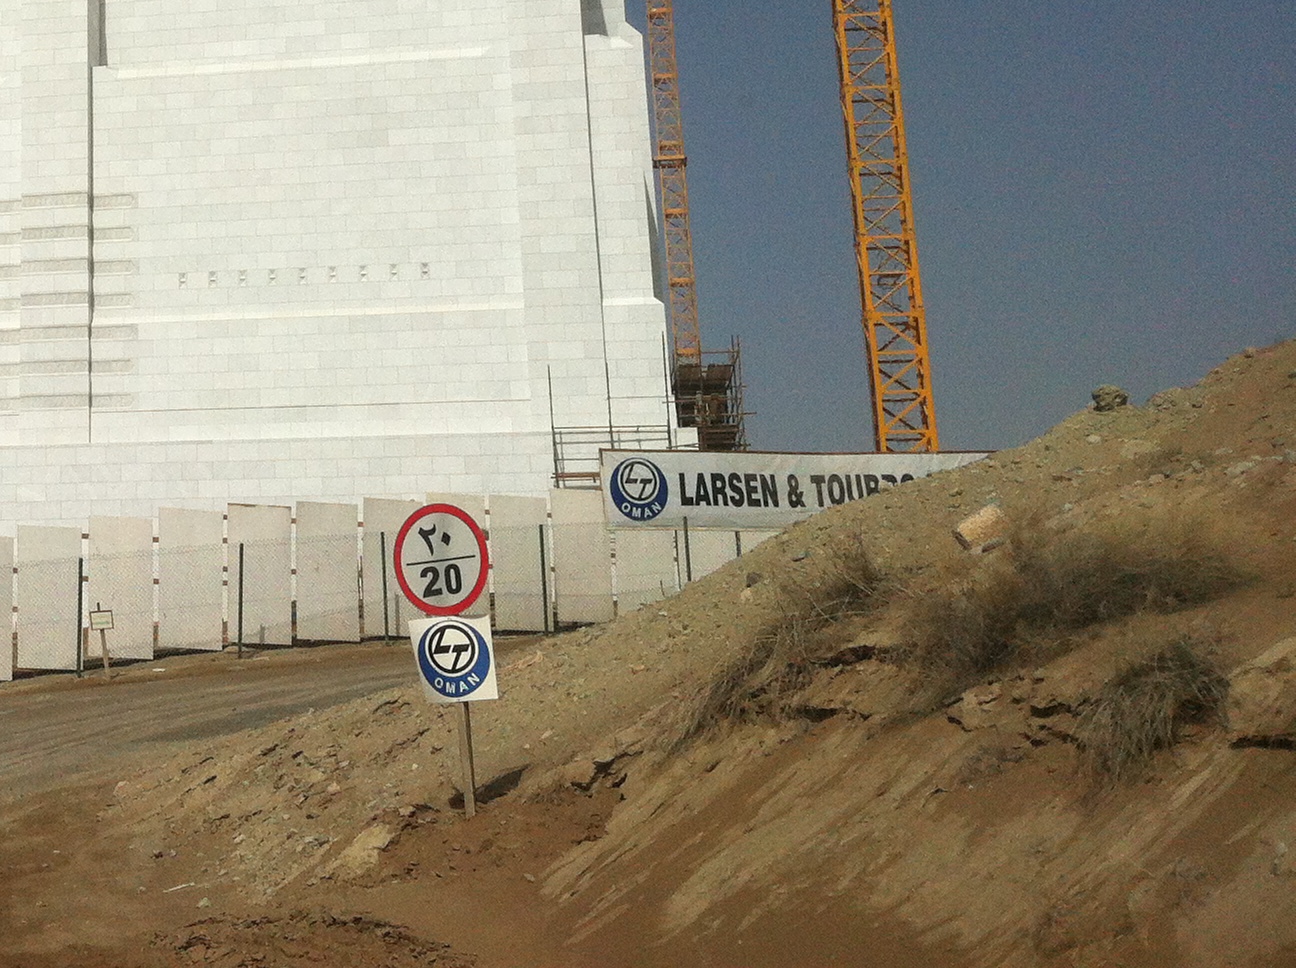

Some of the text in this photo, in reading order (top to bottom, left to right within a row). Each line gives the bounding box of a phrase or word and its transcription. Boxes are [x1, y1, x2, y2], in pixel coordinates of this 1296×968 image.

[678, 472, 915, 508] LARSEN & TOUB
[621, 501, 662, 519] OMAN
[417, 523, 452, 557] ٢٠
[419, 563, 463, 599] 20
[434, 672, 480, 695] OMAN
